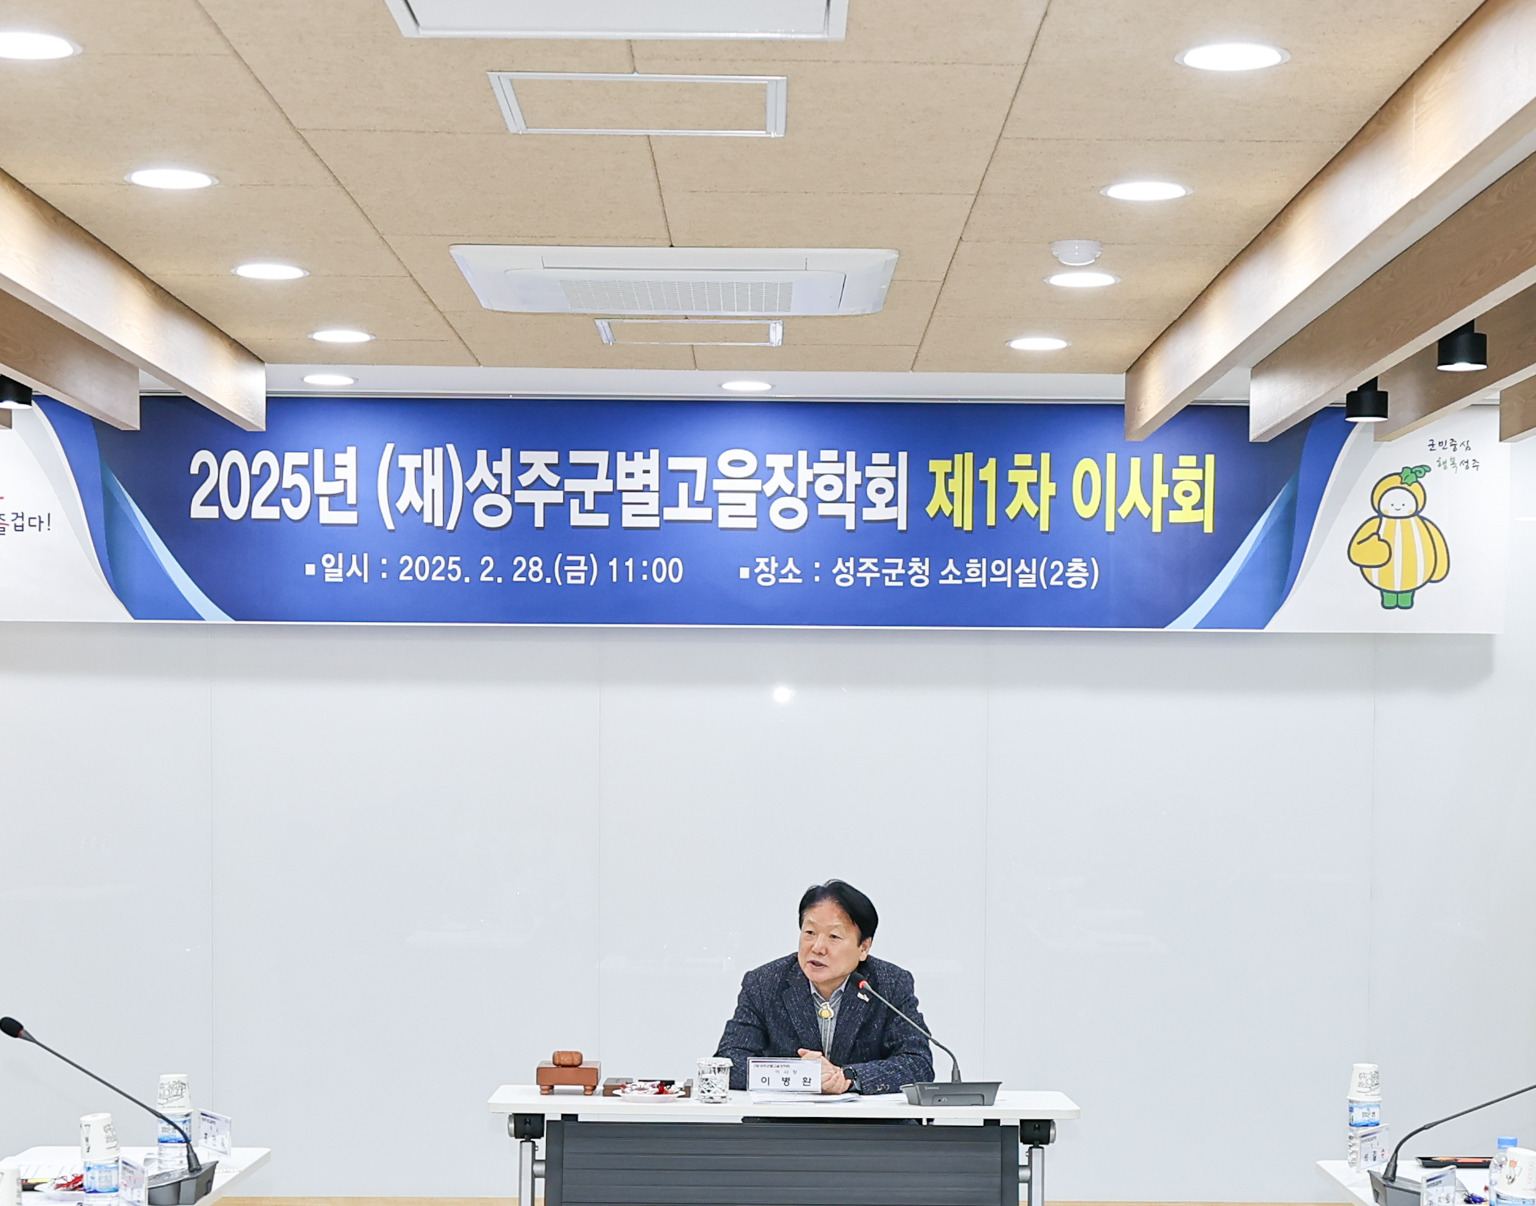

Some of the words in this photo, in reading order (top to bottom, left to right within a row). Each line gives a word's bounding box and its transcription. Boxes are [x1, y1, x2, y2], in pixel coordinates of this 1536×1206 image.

[189, 445, 359, 525] 2025년
[376, 442, 909, 532] (재)성주군별고을장학회
[925, 452, 1057, 533] 제1차
[1072, 453, 1216, 535] 이사회
[320, 552, 369, 583] 일시
[398, 555, 471, 583] 2025.
[479, 555, 504, 583] 2.
[512, 553, 599, 586] 28.(금)
[607, 556, 684, 584] 11:00
[753, 555, 804, 587] 장소
[830, 556, 931, 588] 성주군청
